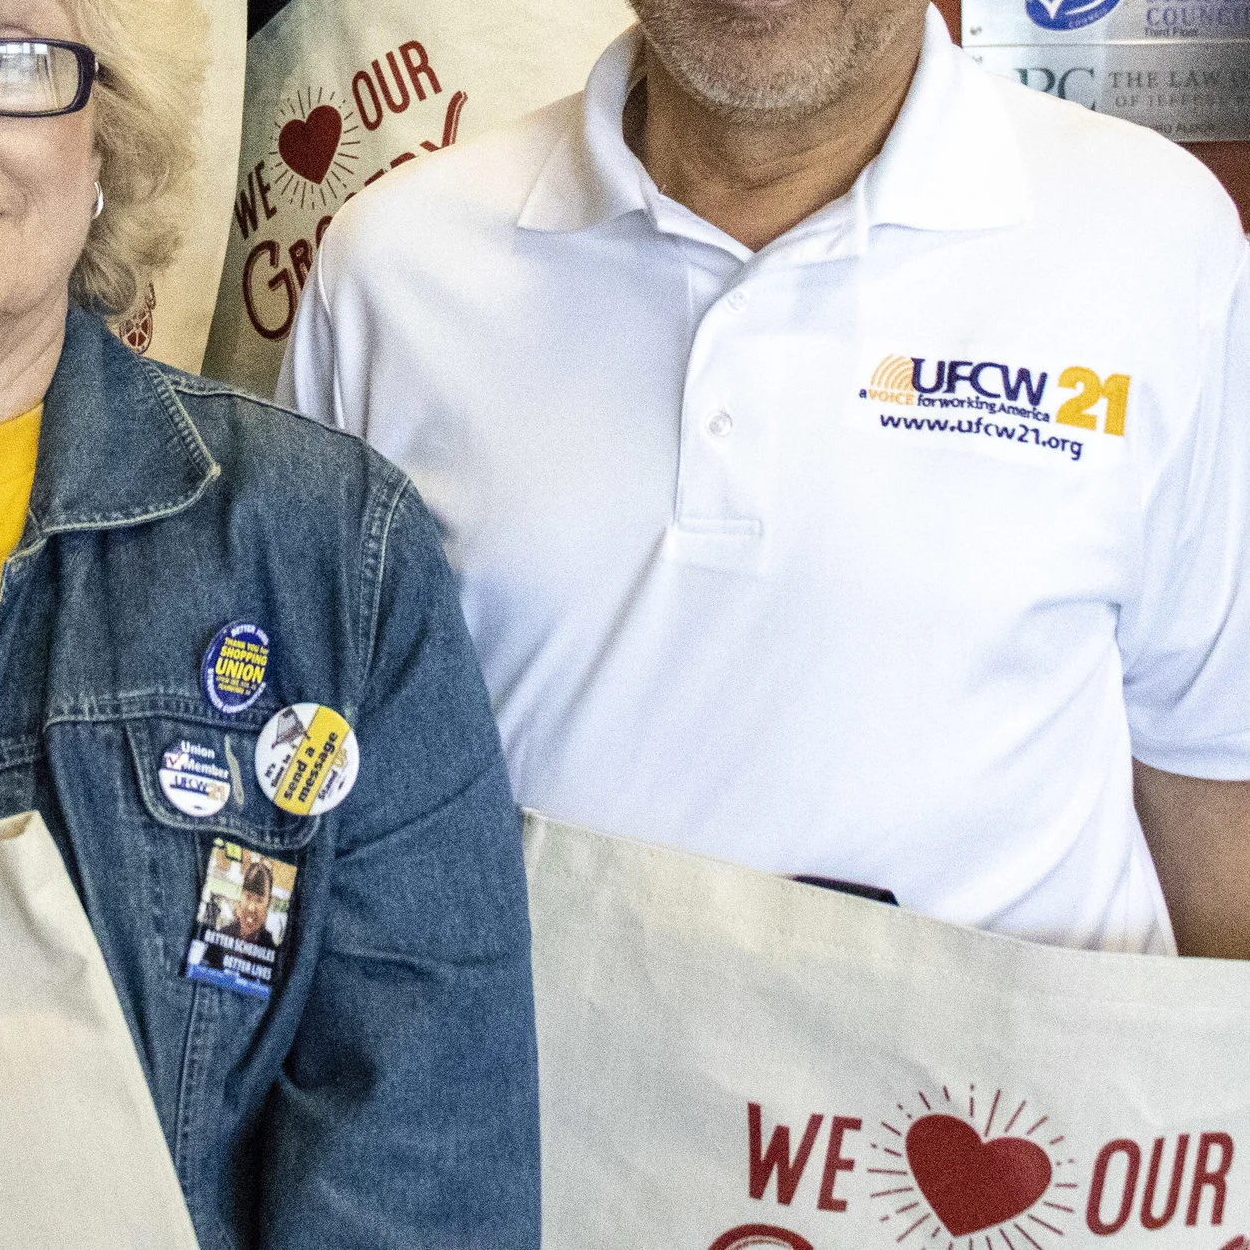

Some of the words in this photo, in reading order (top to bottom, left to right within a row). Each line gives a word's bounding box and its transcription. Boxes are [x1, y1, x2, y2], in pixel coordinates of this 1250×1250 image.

[1108, 70, 1159, 88] THE
[1168, 69, 1221, 88] LAW
[234, 159, 278, 241] WE
[351, 40, 443, 131] OUR
[859, 388, 867, 400] a
[868, 388, 916, 407] VOICE
[999, 401, 1051, 424] America
[910, 357, 1048, 407] UFCW
[1055, 365, 1132, 437] 21
[880, 413, 1085, 461] www.ufcw21.org
[215, 657, 265, 684] UNION
[220, 645, 268, 666] SHOPPING
[181, 740, 215, 759] Union
[183, 758, 229, 780] Member
[298, 732, 338, 803] message
[284, 759, 307, 800] send
[305, 746, 315, 758] a
[747, 1102, 862, 1213] WE
[1085, 1132, 1235, 1237] OUR
